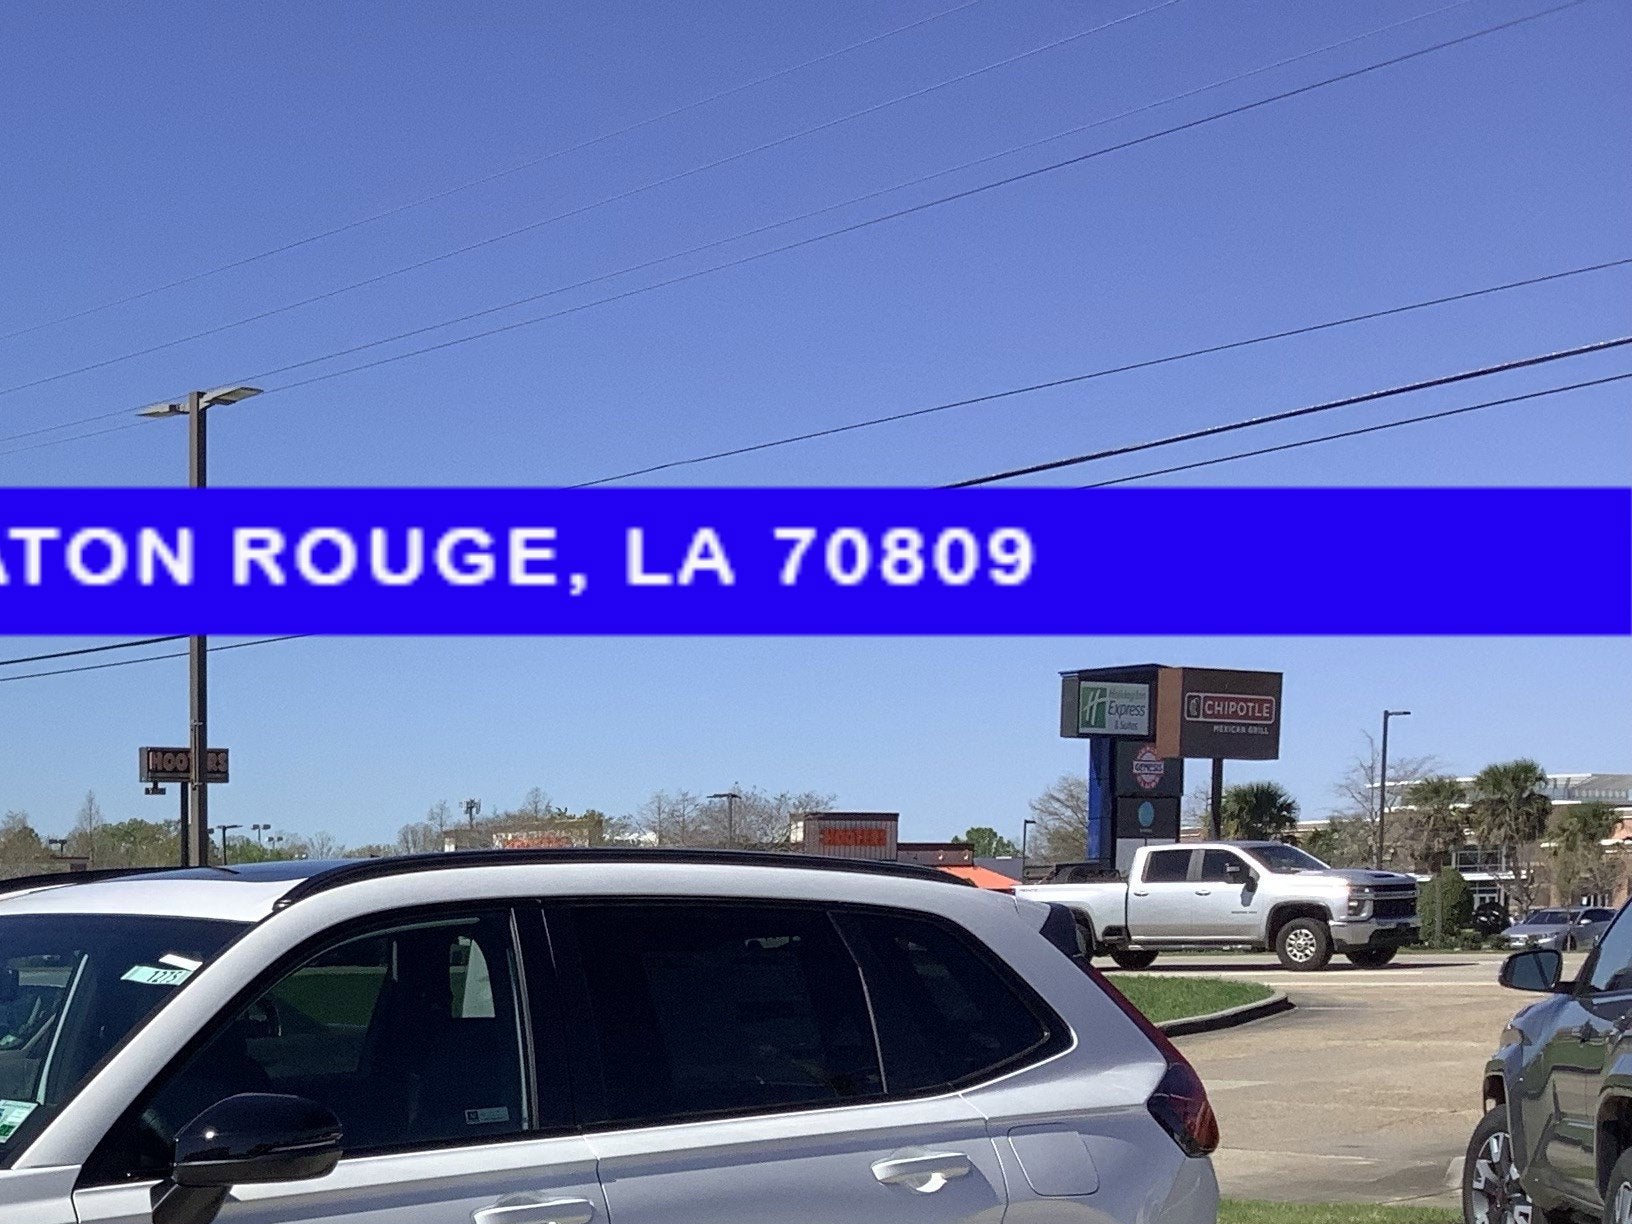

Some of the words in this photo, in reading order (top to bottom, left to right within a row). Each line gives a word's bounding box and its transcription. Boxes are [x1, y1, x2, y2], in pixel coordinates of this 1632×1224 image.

[1108, 700, 1146, 717] Express
[1204, 700, 1270, 717] CHIPOTLE
[1214, 725, 1246, 734] MEXICAN
[1248, 726, 1269, 735] GRILL
[148, 751, 227, 772] HOORS
